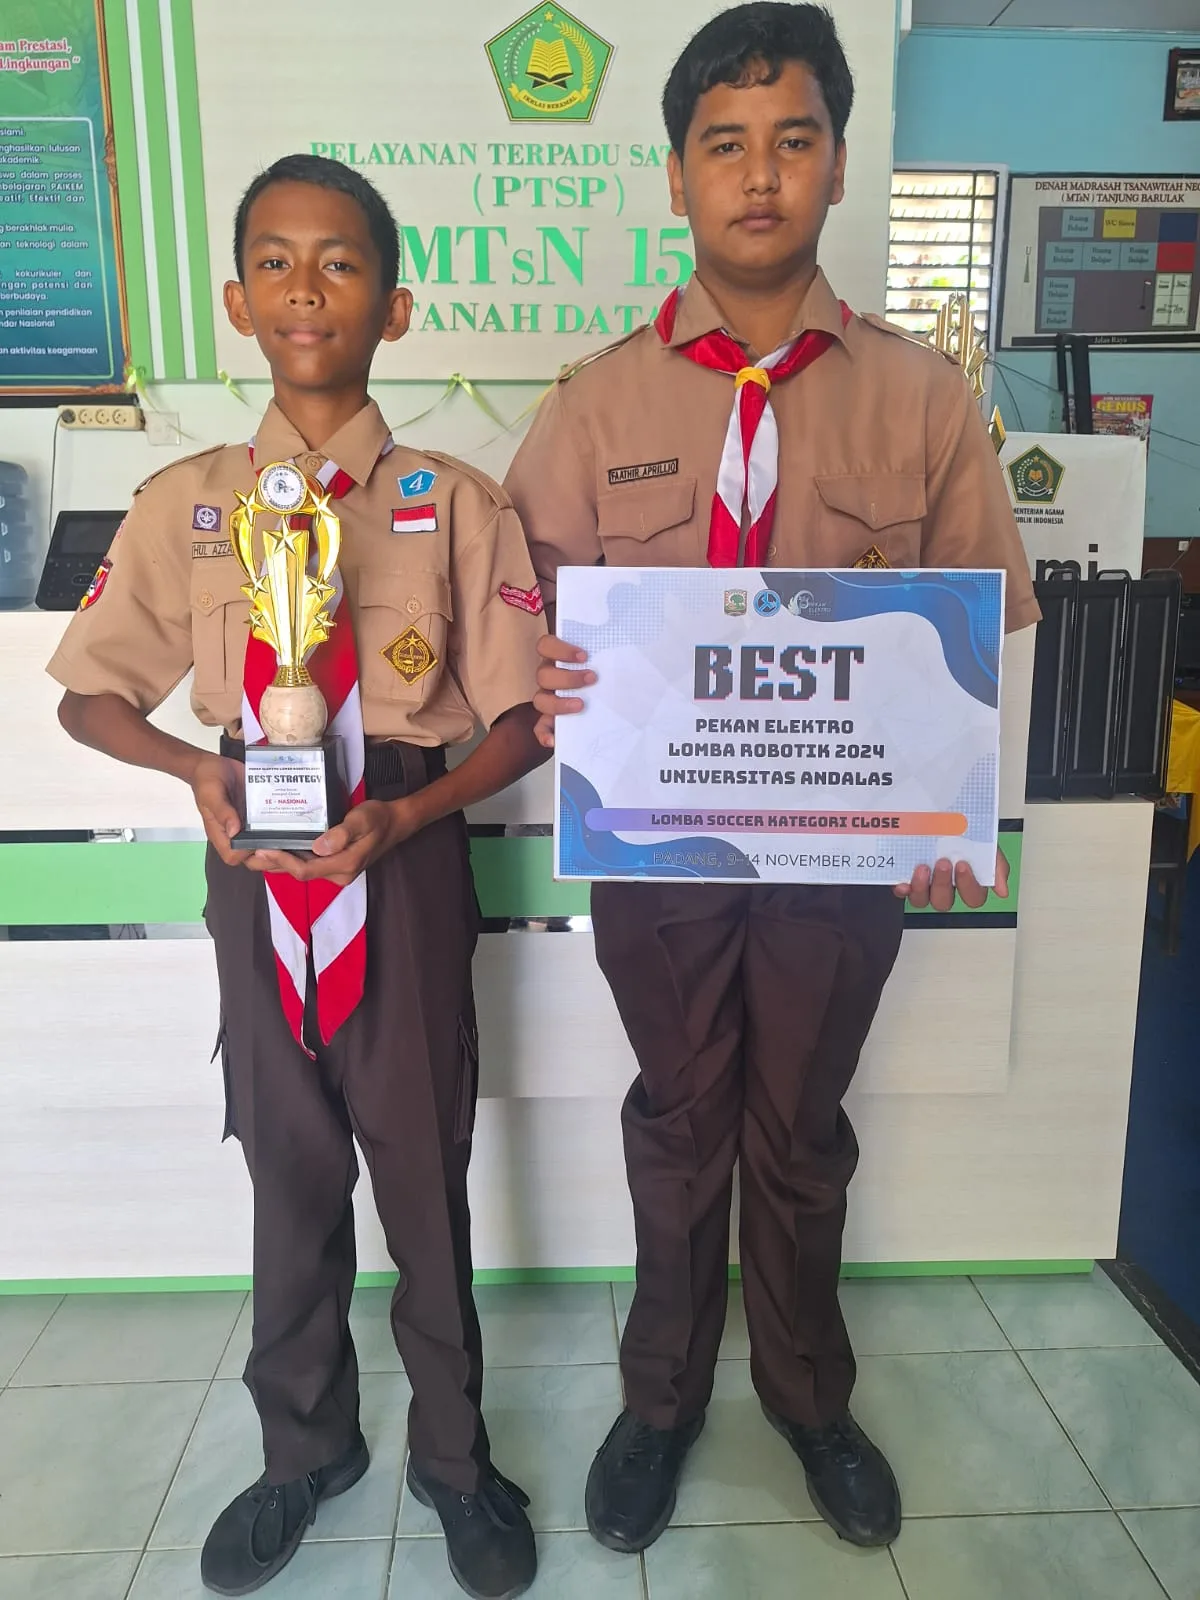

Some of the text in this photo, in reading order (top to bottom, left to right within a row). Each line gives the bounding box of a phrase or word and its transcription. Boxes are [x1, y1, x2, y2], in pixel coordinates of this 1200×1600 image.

[19, 38, 71, 53] Prestasi,
[49, 144, 80, 152] lulusan
[310, 142, 478, 165] PELAYANAN
[488, 143, 620, 166] TERPADU
[21, 170, 49, 178] dalam
[54, 172, 82, 181] proses
[51, 183, 84, 191] PAIKEM
[1035, 182, 1067, 191] DENAH
[1070, 182, 1121, 191] MADRASAH
[1124, 182, 1183, 191] TSANAWIYAH
[66, 194, 85, 202] dan
[1097, 193, 1139, 203] TANJUNG
[1141, 193, 1184, 202] BARULAK
[6, 224, 48, 232] berakhlak
[50, 224, 73, 232] mulia
[16, 240, 55, 250] teknologi
[397, 225, 694, 286] MTsN 15
[75, 269, 92, 277] dan
[32, 281, 69, 291] potensi
[74, 281, 92, 289] dan
[5, 308, 43, 317] penilaian
[45, 308, 92, 318] pendidikan
[408, 302, 542, 333] ANAH
[19, 319, 55, 327] Nasional
[47, 347, 98, 356] keagamaan
[409, 476, 424, 491] 4
[1045, 508, 1064, 516] AGAMA
[1034, 517, 1064, 525] INDONESIA
[694, 644, 865, 702] BEST
[695, 718, 854, 734] PEKAN ELEKTRO
[668, 742, 885, 759] LOMBA ROBOTIK 2024
[248, 774, 322, 784] BEST STRATEGY
[659, 769, 893, 786] UNIVERSITAS ANDALAS
[651, 814, 900, 828] LOMBA SOCCER KATEGORI CLOSE
[653, 851, 722, 867] PADANG,
[766, 853, 851, 868] NOVEMBER
[856, 855, 896, 868] 2024
